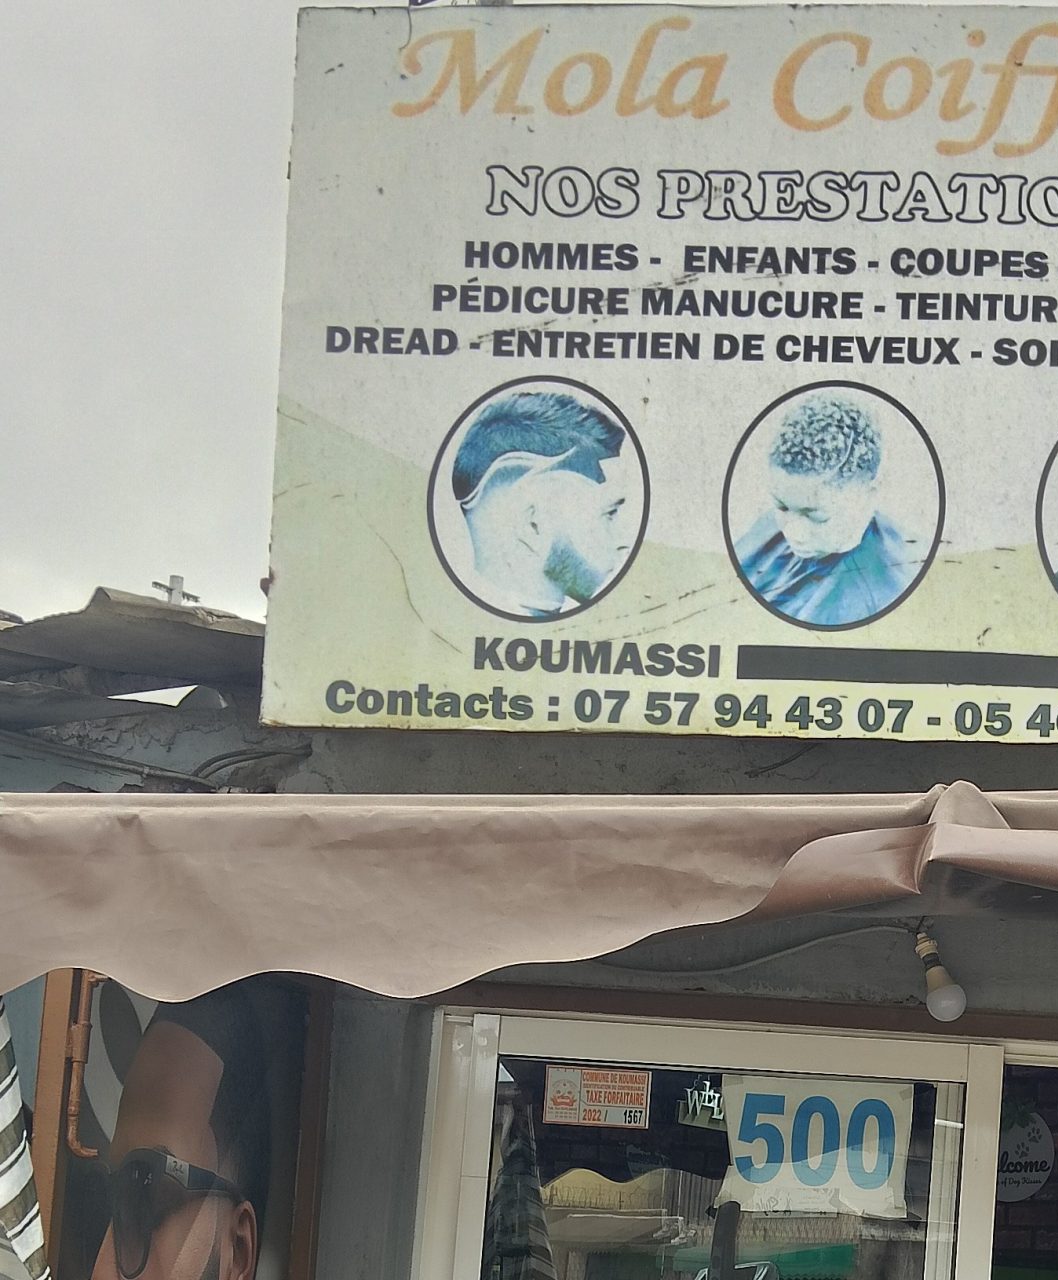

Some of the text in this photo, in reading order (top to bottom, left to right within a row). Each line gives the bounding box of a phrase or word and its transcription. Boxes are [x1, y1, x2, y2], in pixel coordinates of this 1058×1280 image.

[391, 15, 731, 120] Mola
[485, 164, 641, 219] NOS
[465, 241, 638, 270] HOMMES
[684, 246, 856, 277] ENFANTS
[891, 248, 1048, 278] COUPES
[433, 276, 629, 315] PÉDICURE
[642, 288, 863, 319] MANUCURE
[327, 326, 457, 355] DREAD
[492, 329, 700, 359] ENTRETIEN
[714, 334, 764, 360] DE
[776, 335, 960, 364] CHEVEUX
[474, 637, 720, 677] KOUMASSI
[326, 680, 533, 720] Contacts
[575, 689, 629, 723] 07
[644, 692, 699, 725] 57
[715, 694, 772, 728] 94
[785, 696, 842, 731] 43
[858, 699, 913, 733] 07
[955, 702, 1012, 736] 05
[582, 1071, 647, 1087] COMMUNE DE KOUMASSI
[586, 1090, 644, 1106] TAXE FORFAITAIRE
[582, 1109, 601, 1121] 2022
[623, 1109, 643, 1124] 1567
[734, 1092, 897, 1190] 500
